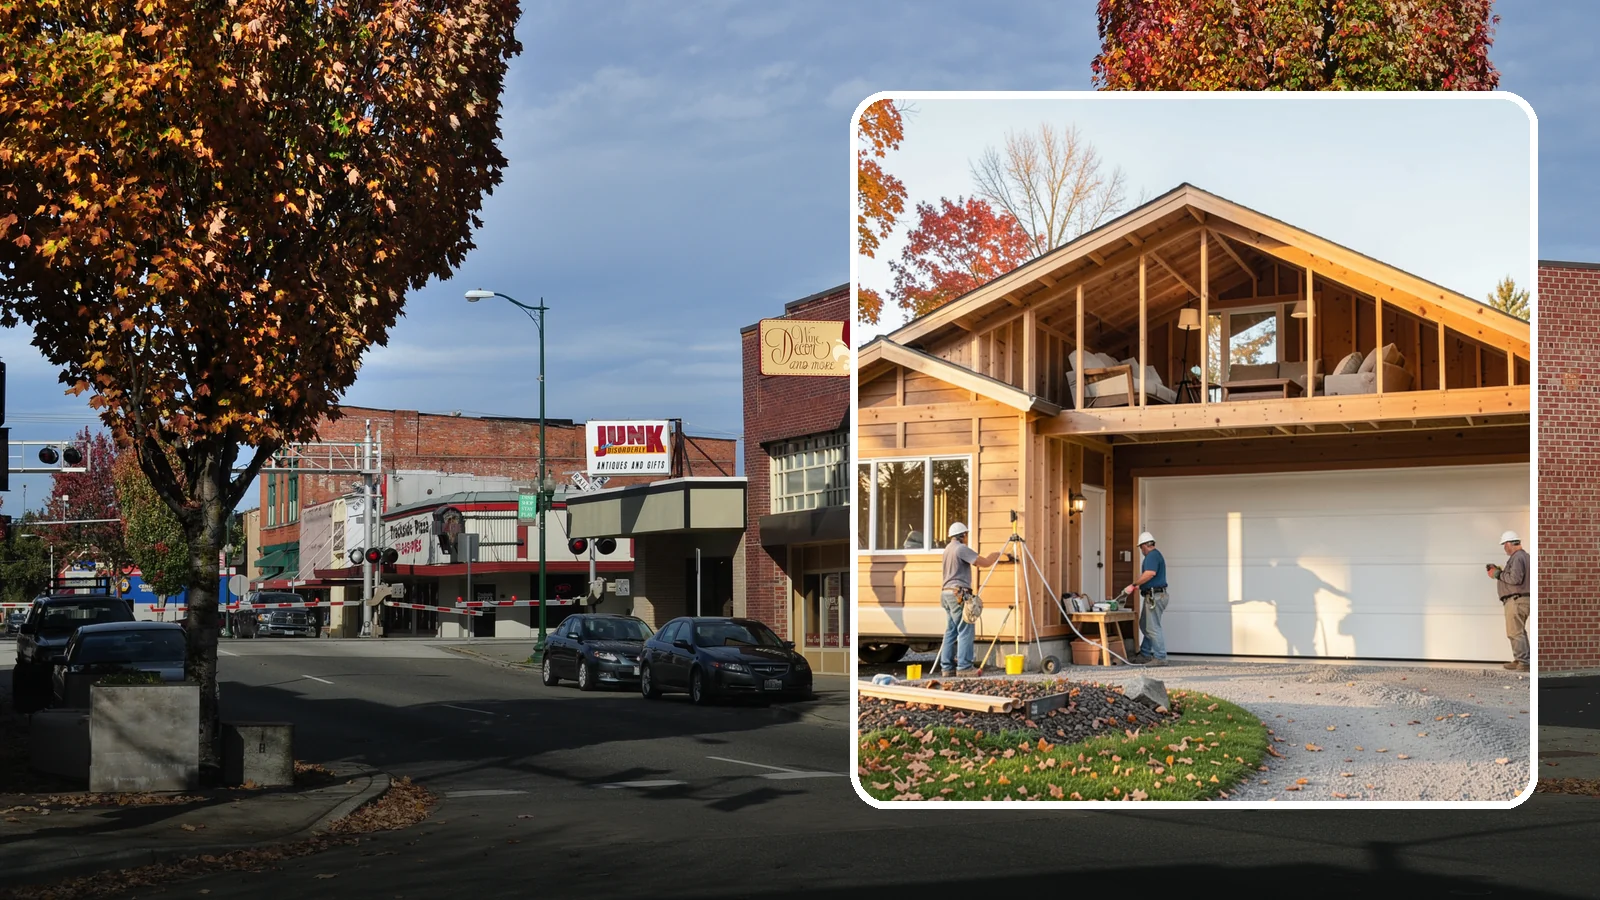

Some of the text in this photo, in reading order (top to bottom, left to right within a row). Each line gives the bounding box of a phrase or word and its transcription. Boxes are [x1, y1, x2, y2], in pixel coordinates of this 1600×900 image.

[595, 425, 664, 457] JUNK
[607, 446, 646, 454] DISORDERLY
[597, 460, 665, 470] ANTIQUES AND GIFTS
[414, 519, 429, 535] Pizza
